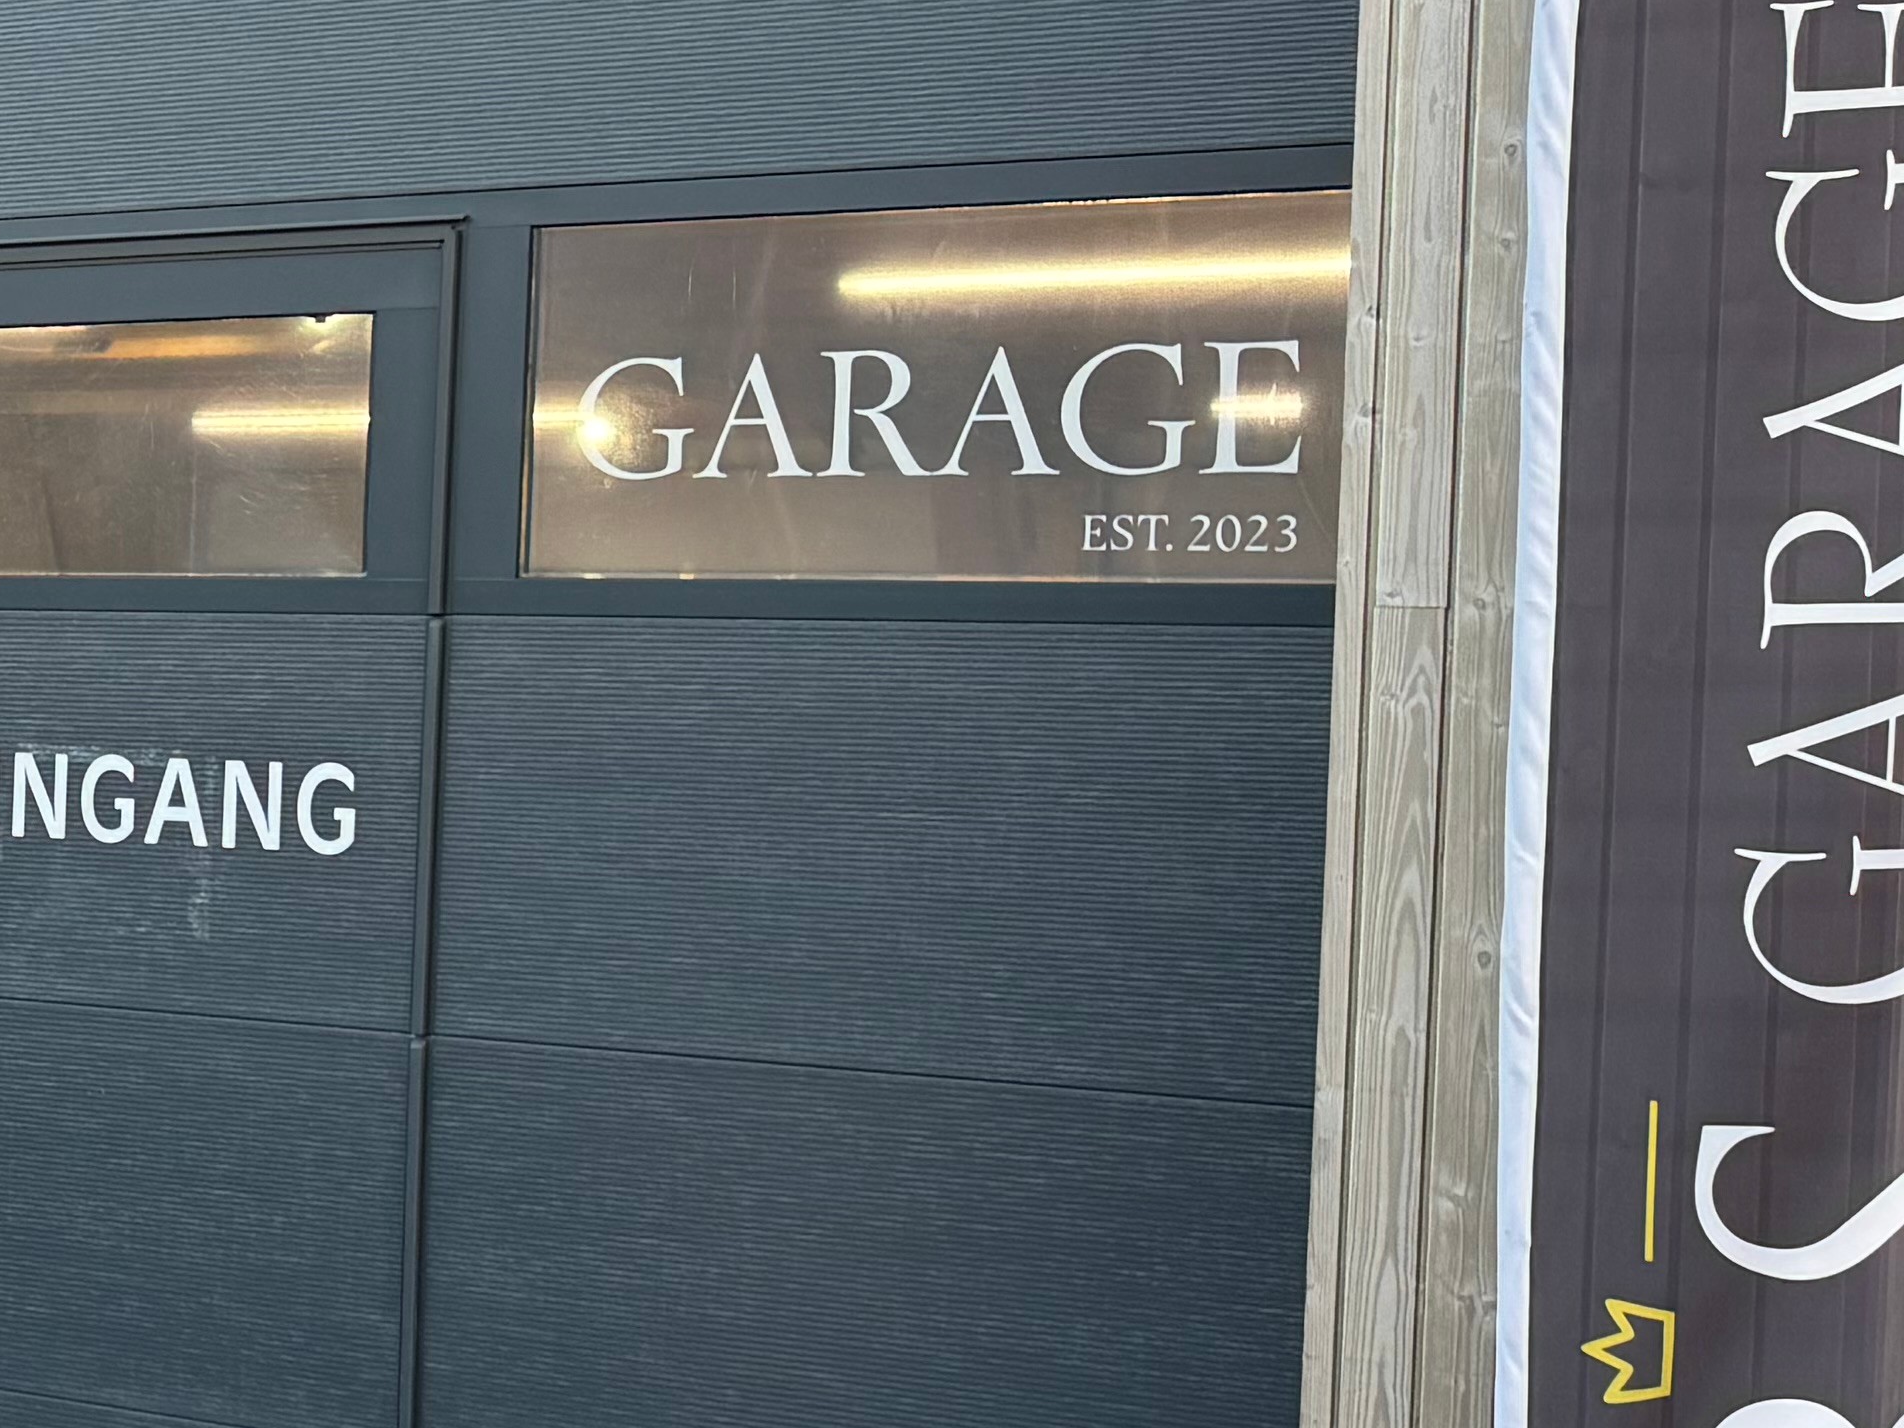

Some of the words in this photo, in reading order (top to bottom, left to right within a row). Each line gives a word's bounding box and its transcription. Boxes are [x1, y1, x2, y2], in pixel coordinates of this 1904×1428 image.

[576, 338, 1304, 481] GARAGE
[1082, 514, 1174, 553] EST.
[1187, 513, 1298, 553] 2023
